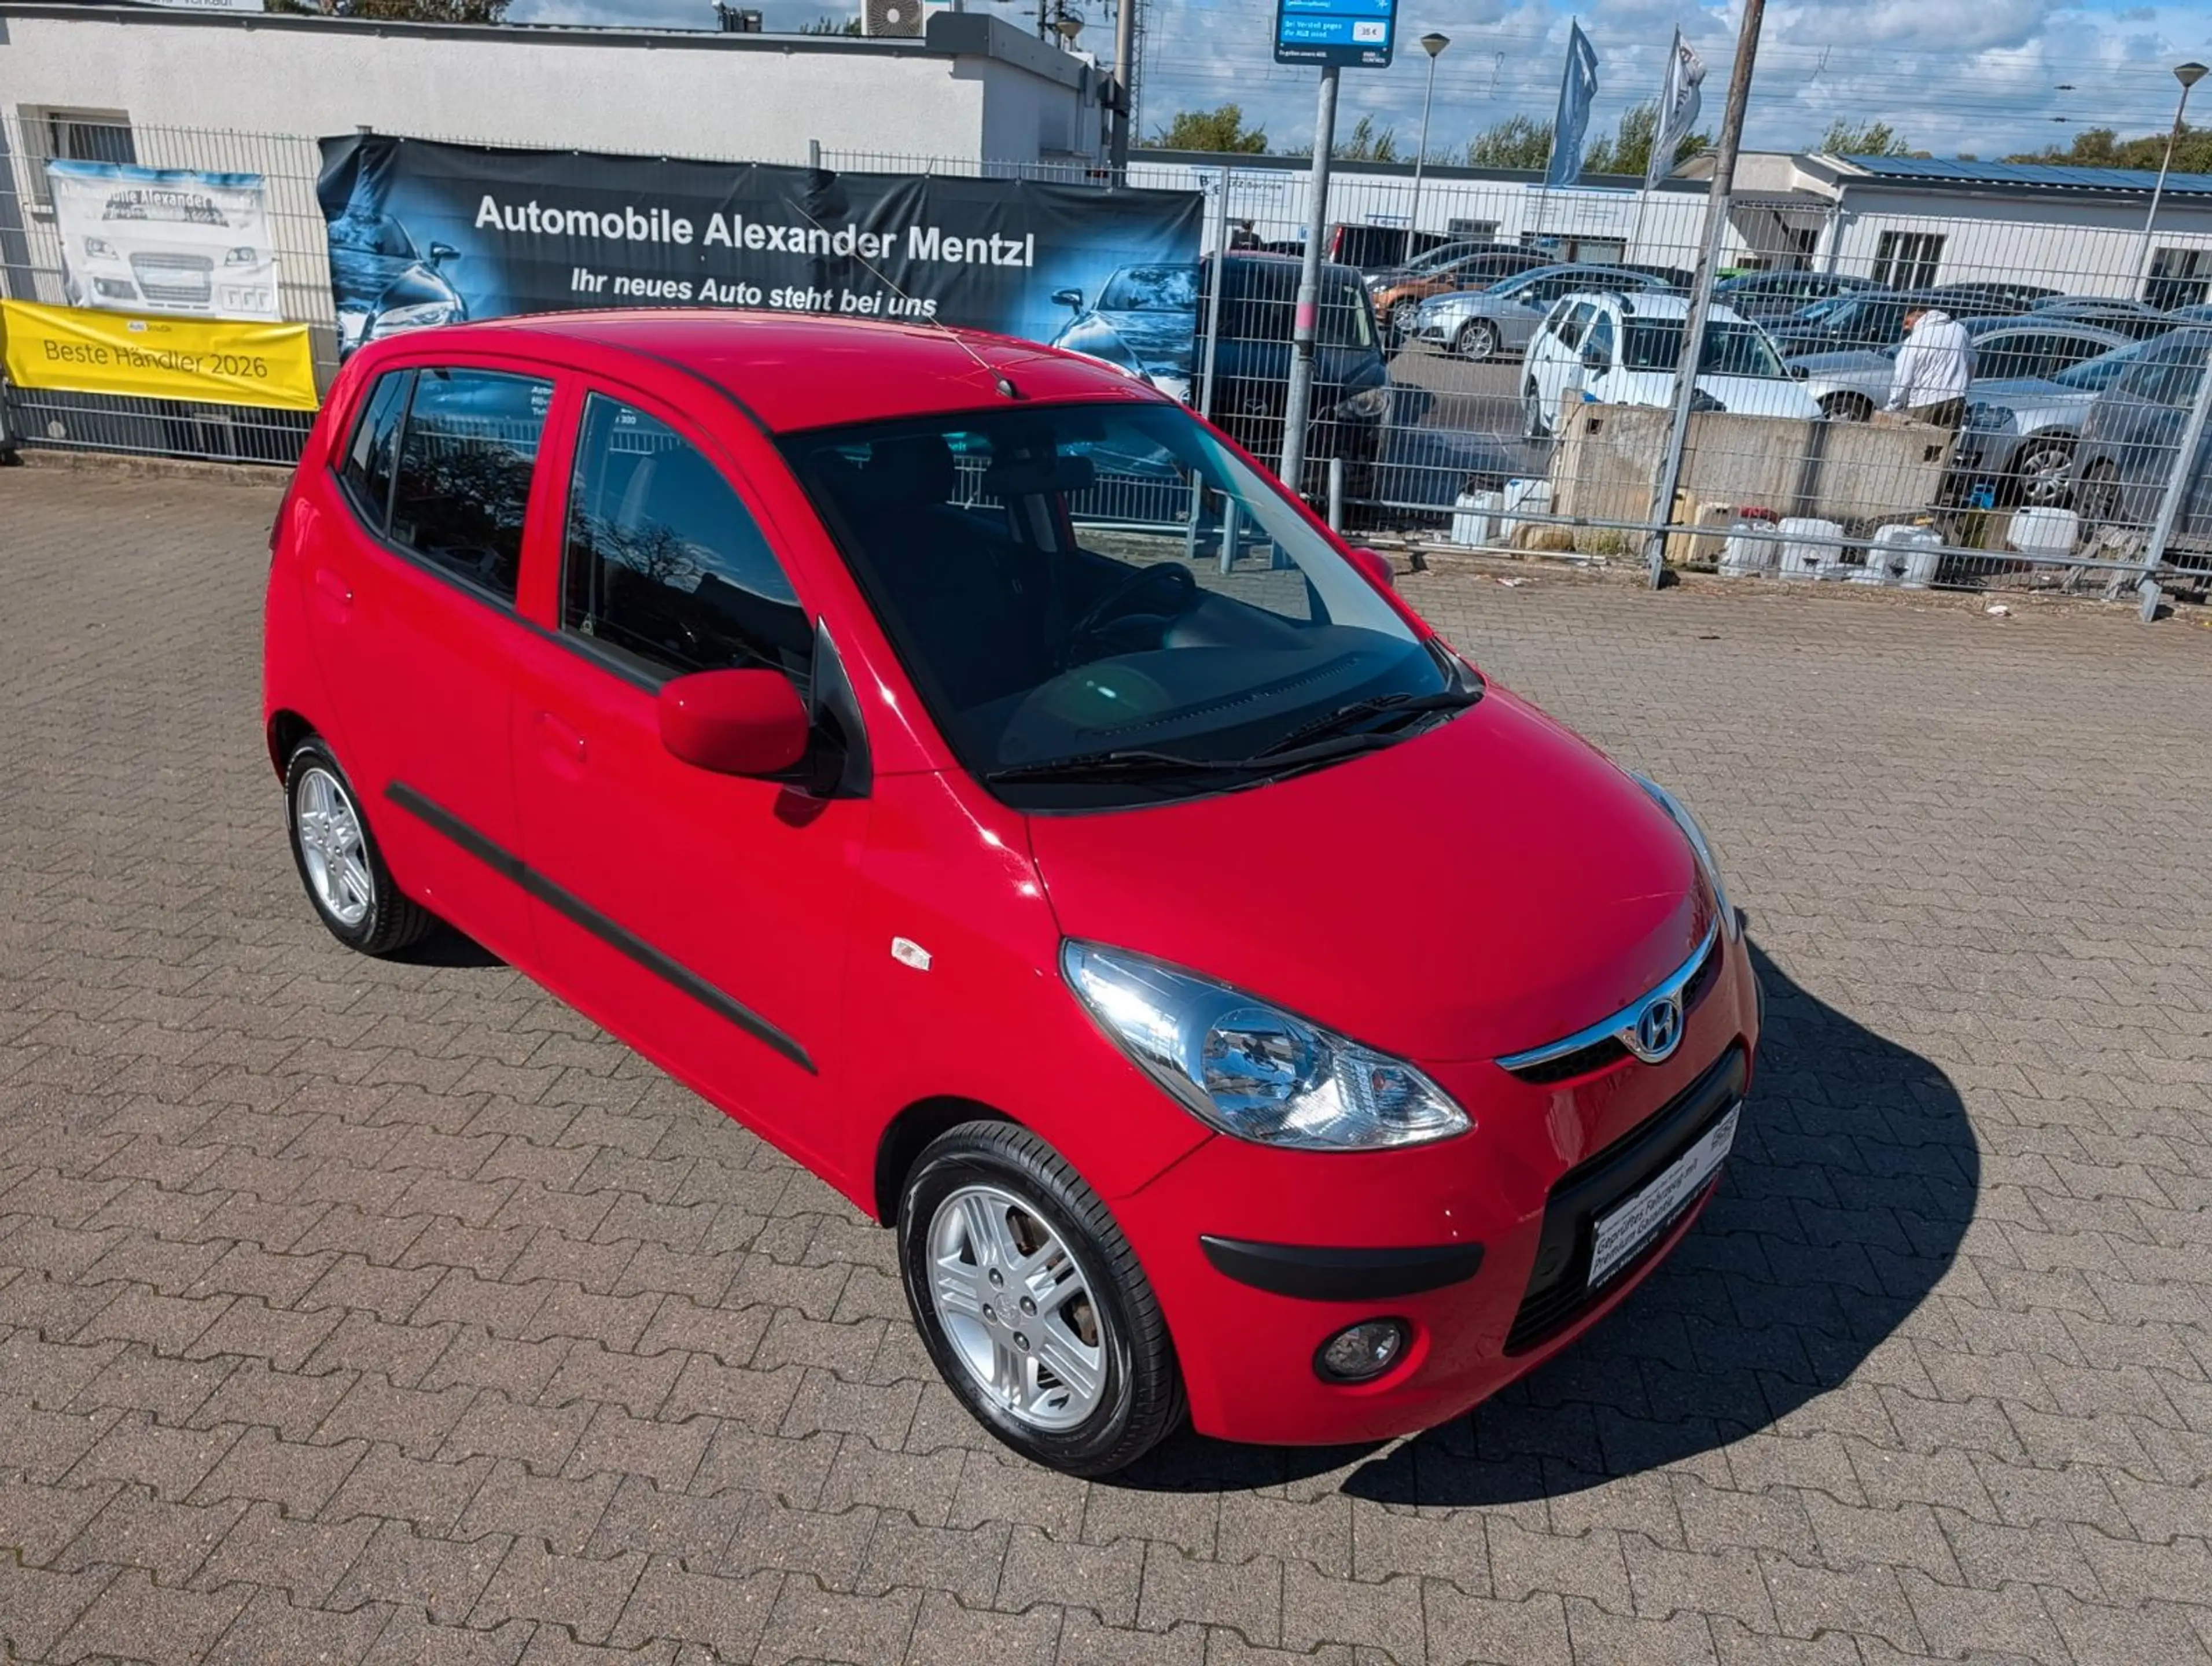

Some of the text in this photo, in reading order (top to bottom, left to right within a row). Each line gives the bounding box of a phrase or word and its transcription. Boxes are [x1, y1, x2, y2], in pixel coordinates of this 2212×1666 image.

[476, 194, 1035, 267] Automobile Alexander Mentzl
[571, 267, 937, 316] Ihr neues Auto steht bei uns
[44, 340, 268, 378] Beste Händler 2026
[1593, 1229, 1636, 1271] Premium
[1597, 1209, 1644, 1254] Geprüftes
